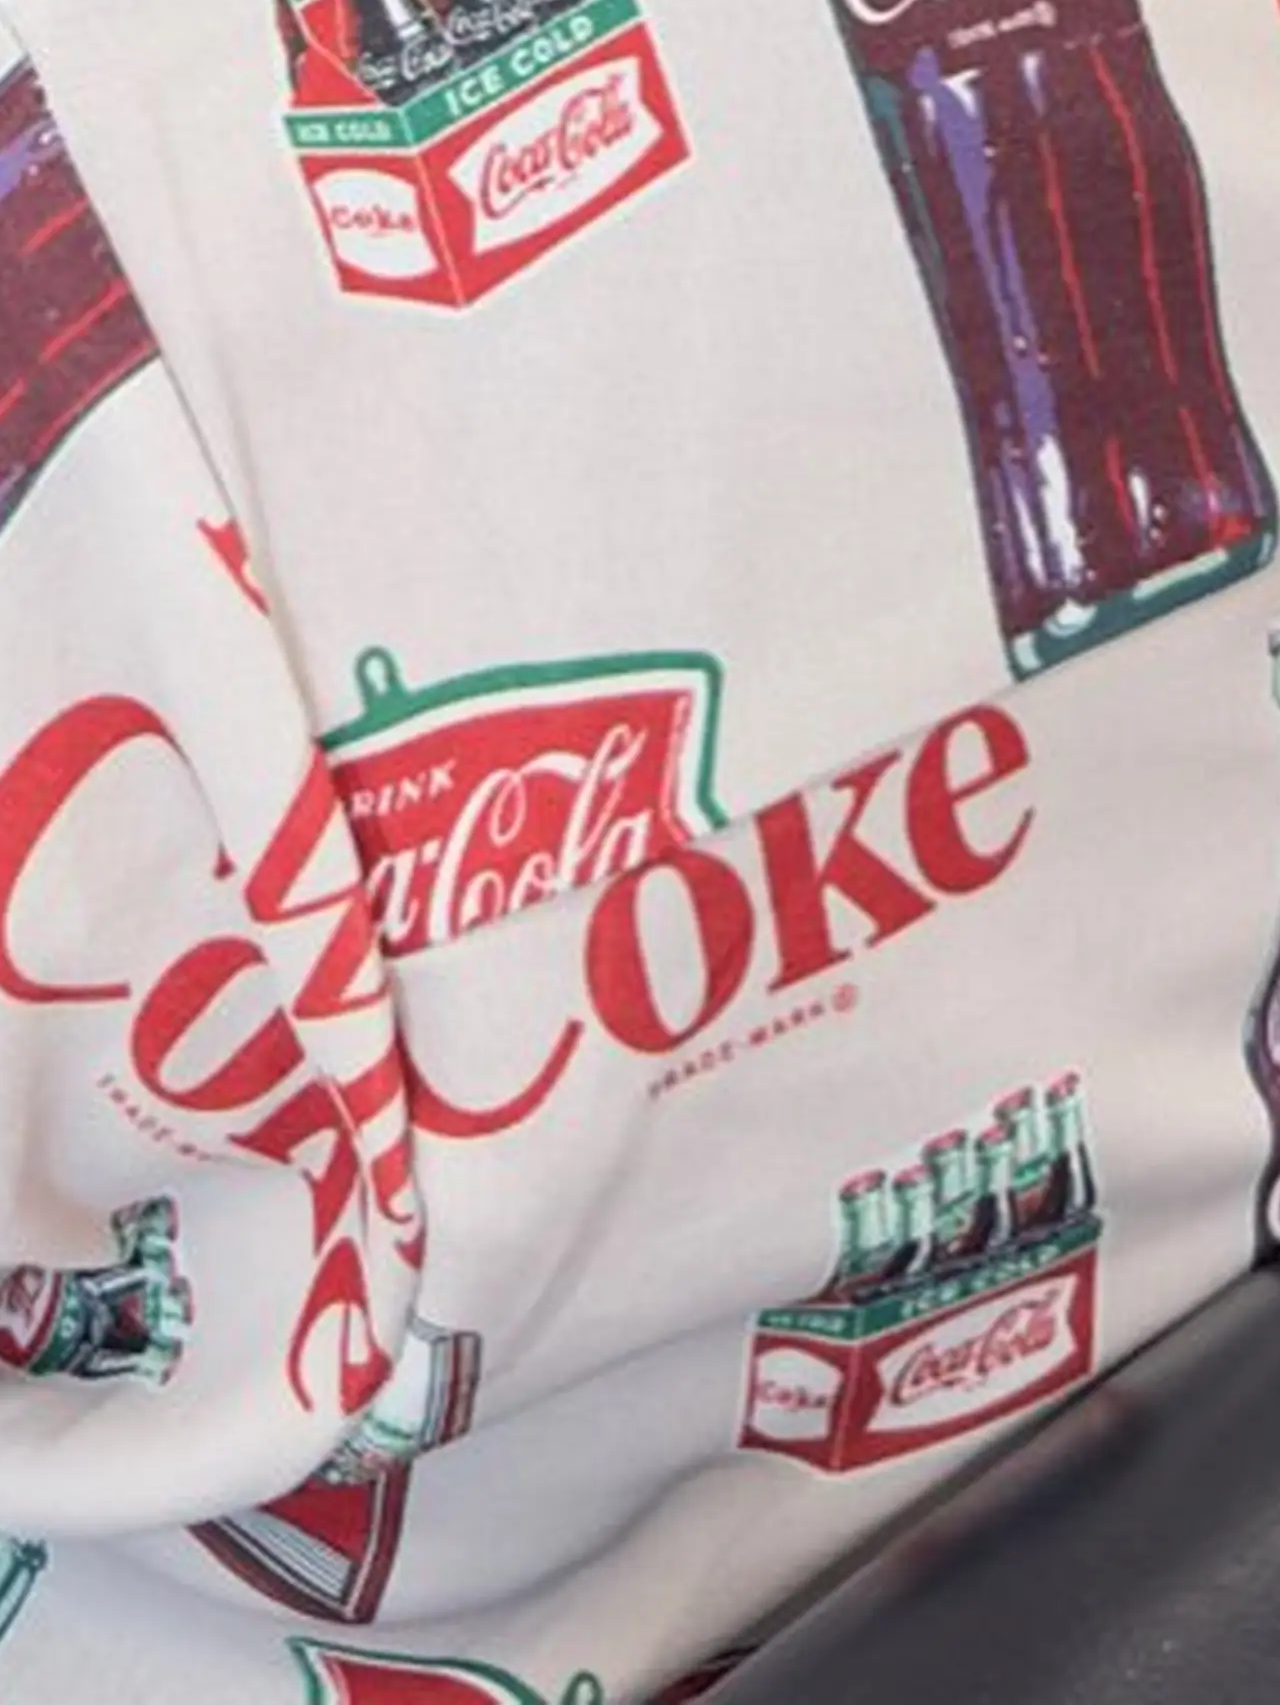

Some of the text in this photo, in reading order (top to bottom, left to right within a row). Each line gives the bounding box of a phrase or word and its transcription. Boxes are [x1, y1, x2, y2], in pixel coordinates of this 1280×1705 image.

[443, 66, 503, 117] ICE
[510, 16, 594, 76] COLD
[349, 758, 459, 817] RINK
